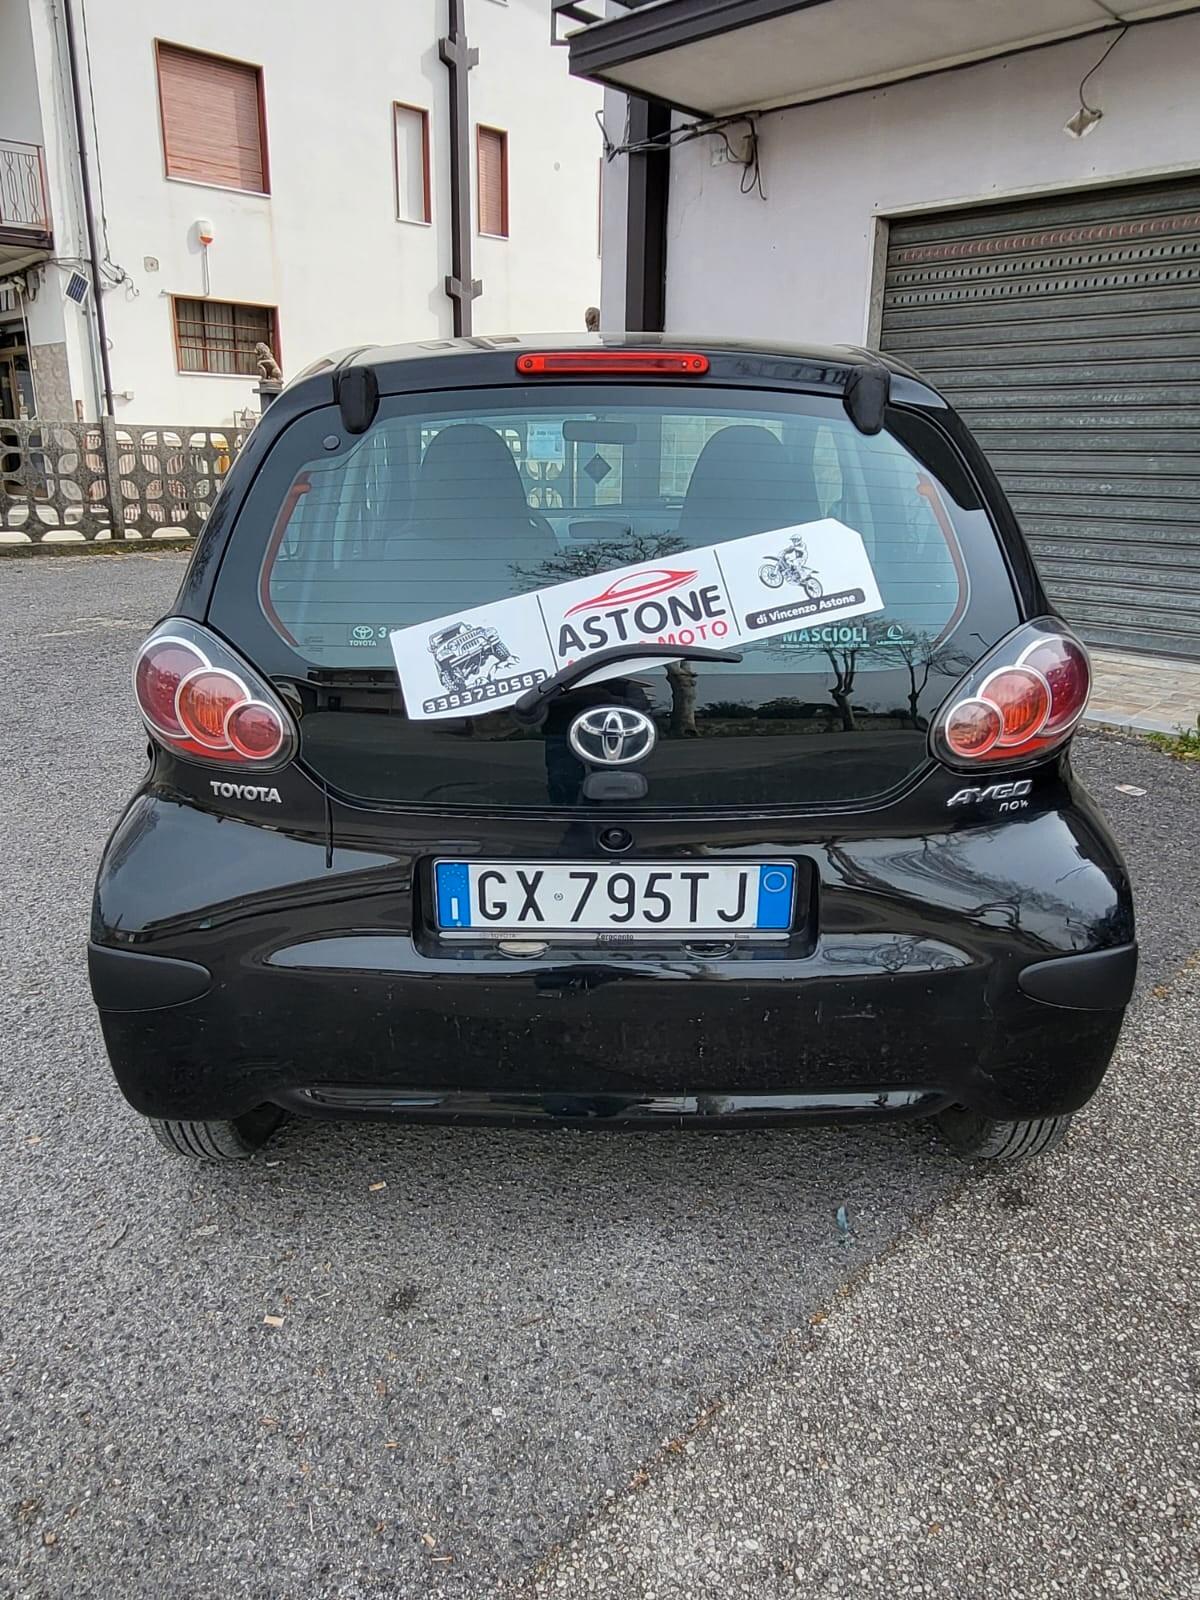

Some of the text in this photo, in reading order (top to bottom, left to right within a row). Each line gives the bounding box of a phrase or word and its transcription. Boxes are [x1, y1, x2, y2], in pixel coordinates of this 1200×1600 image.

[559, 585, 726, 657] ASTONE
[756, 594, 856, 625] di Vincenzo Astone
[658, 620, 728, 646] MOTO
[783, 627, 867, 642] MASCIOLI
[424, 671, 546, 713] 3393720583
[210, 780, 282, 803] TOYOTA
[946, 780, 1032, 807] AYGO
